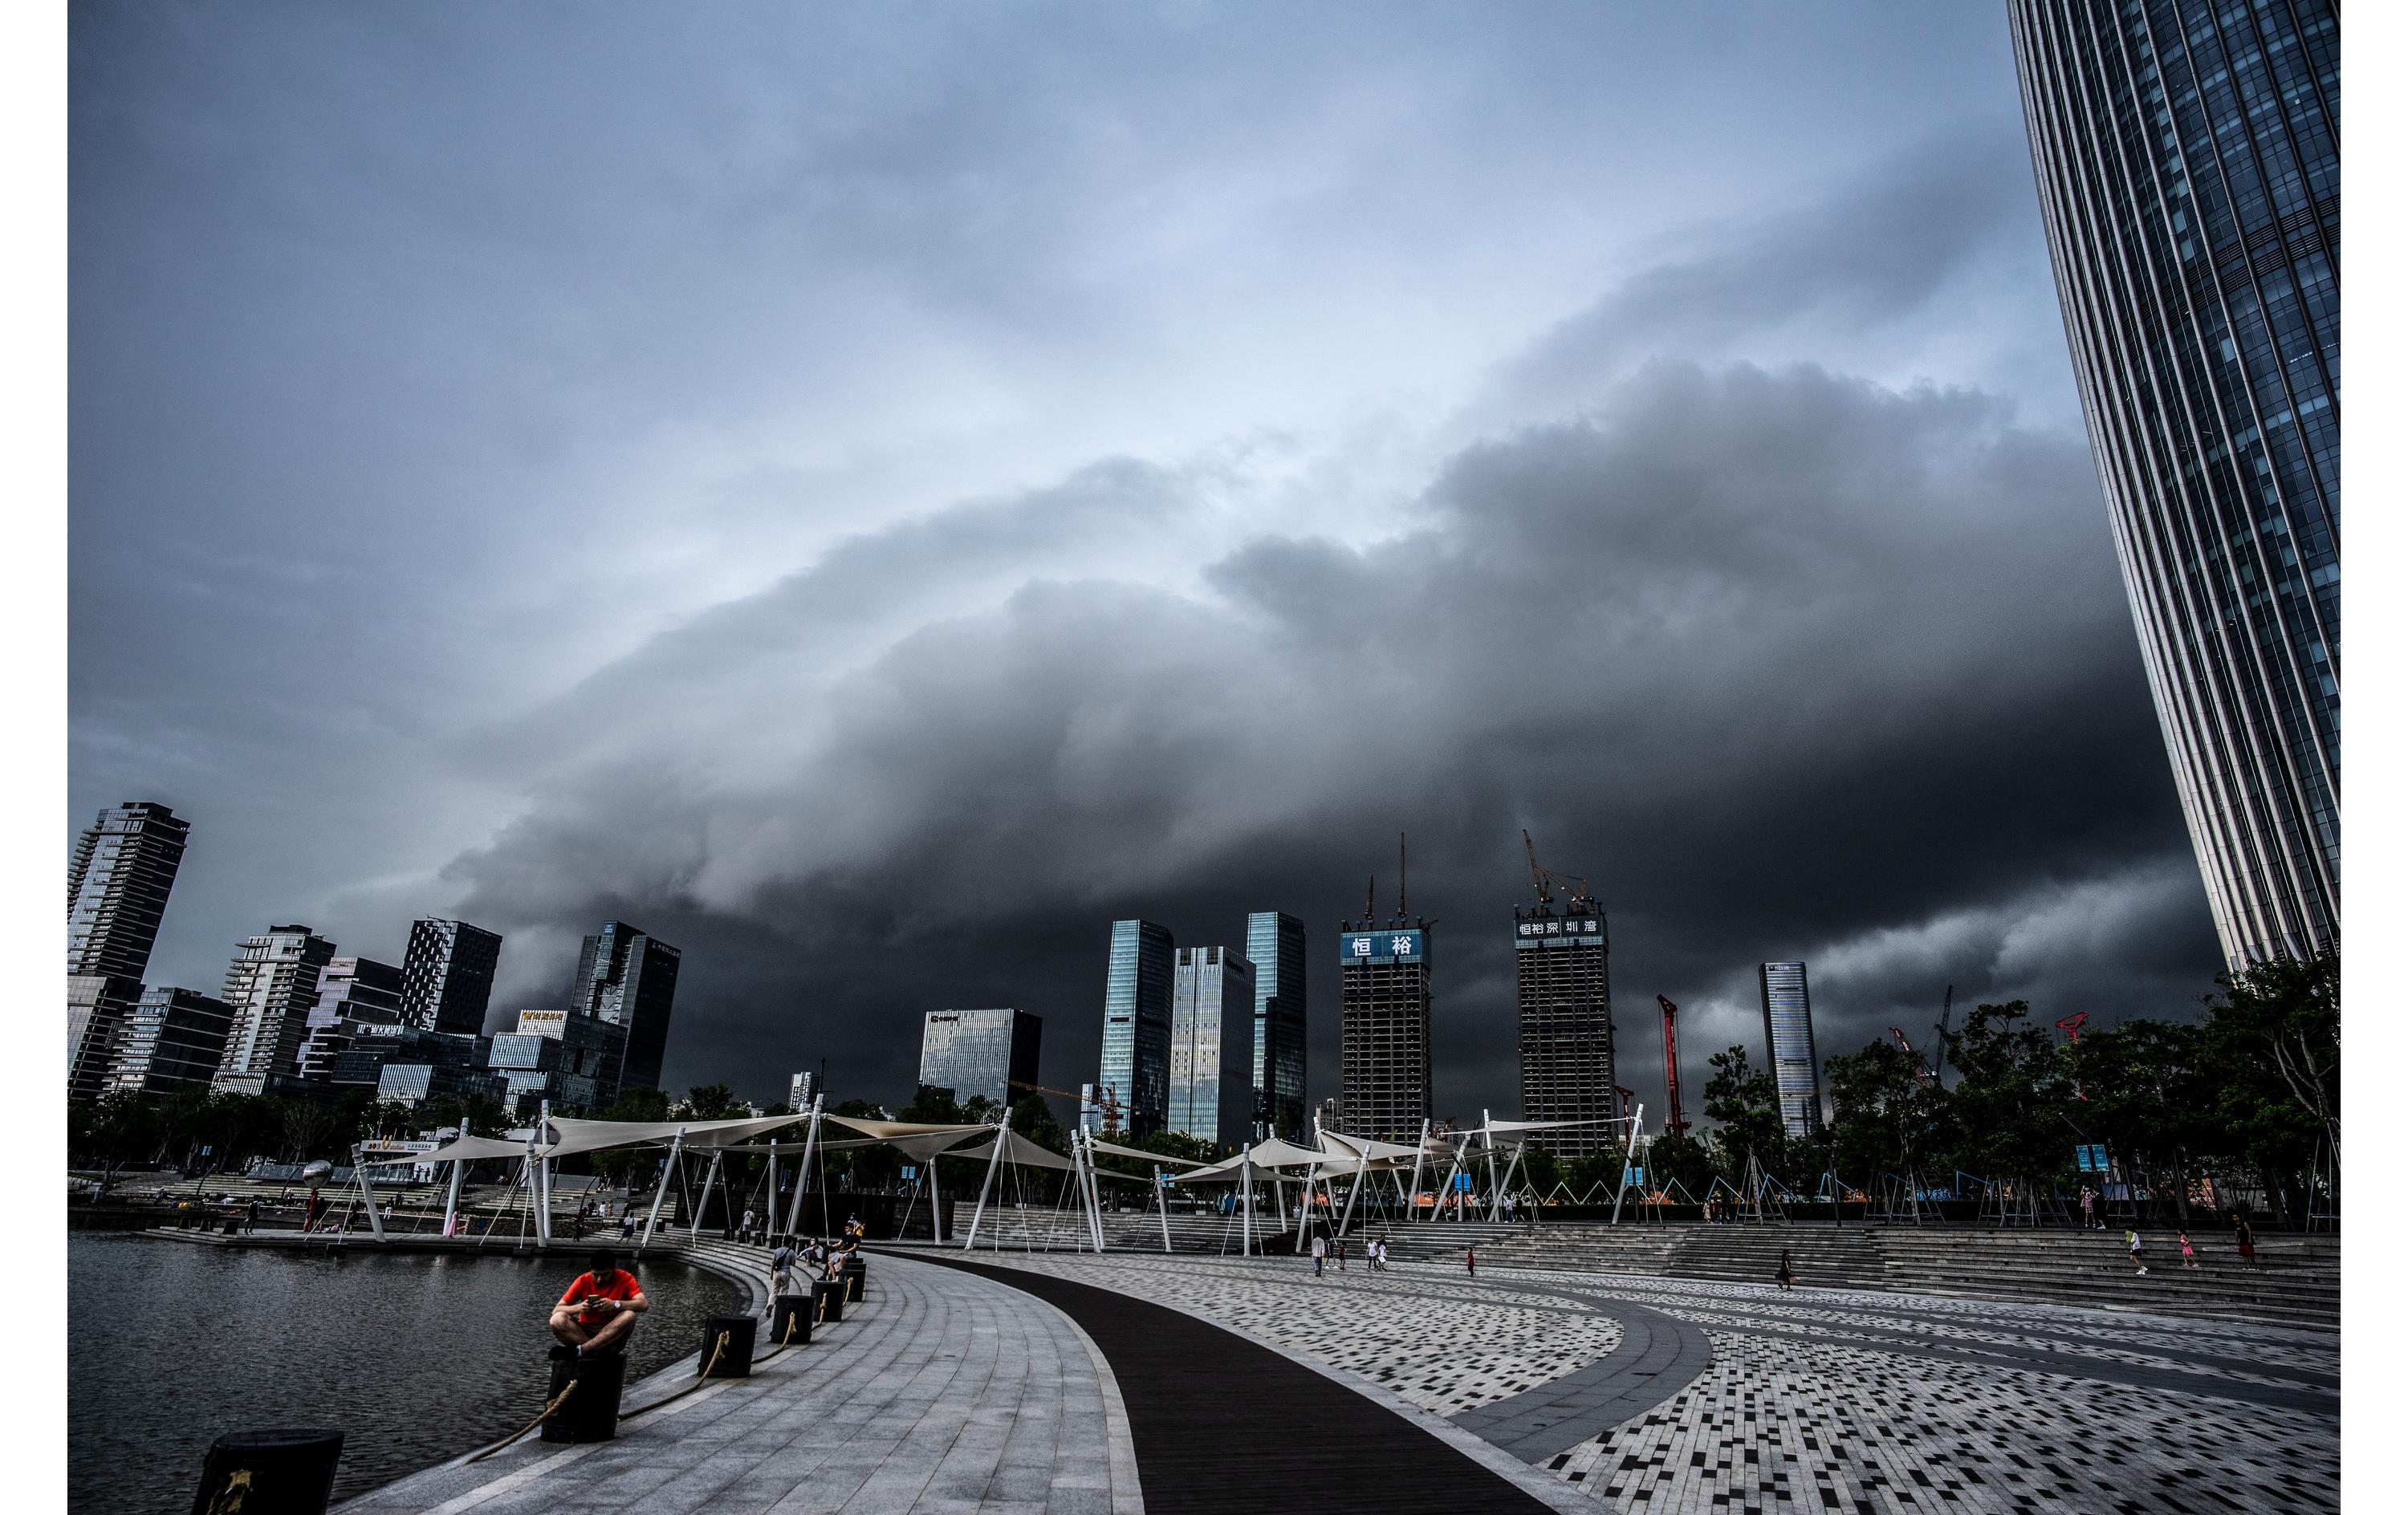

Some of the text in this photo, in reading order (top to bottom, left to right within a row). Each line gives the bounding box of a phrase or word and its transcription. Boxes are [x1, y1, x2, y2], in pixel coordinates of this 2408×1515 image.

[1519, 920, 1597, 935] 恒裕深圳湾
[1352, 936, 1412, 957] 恒裕
